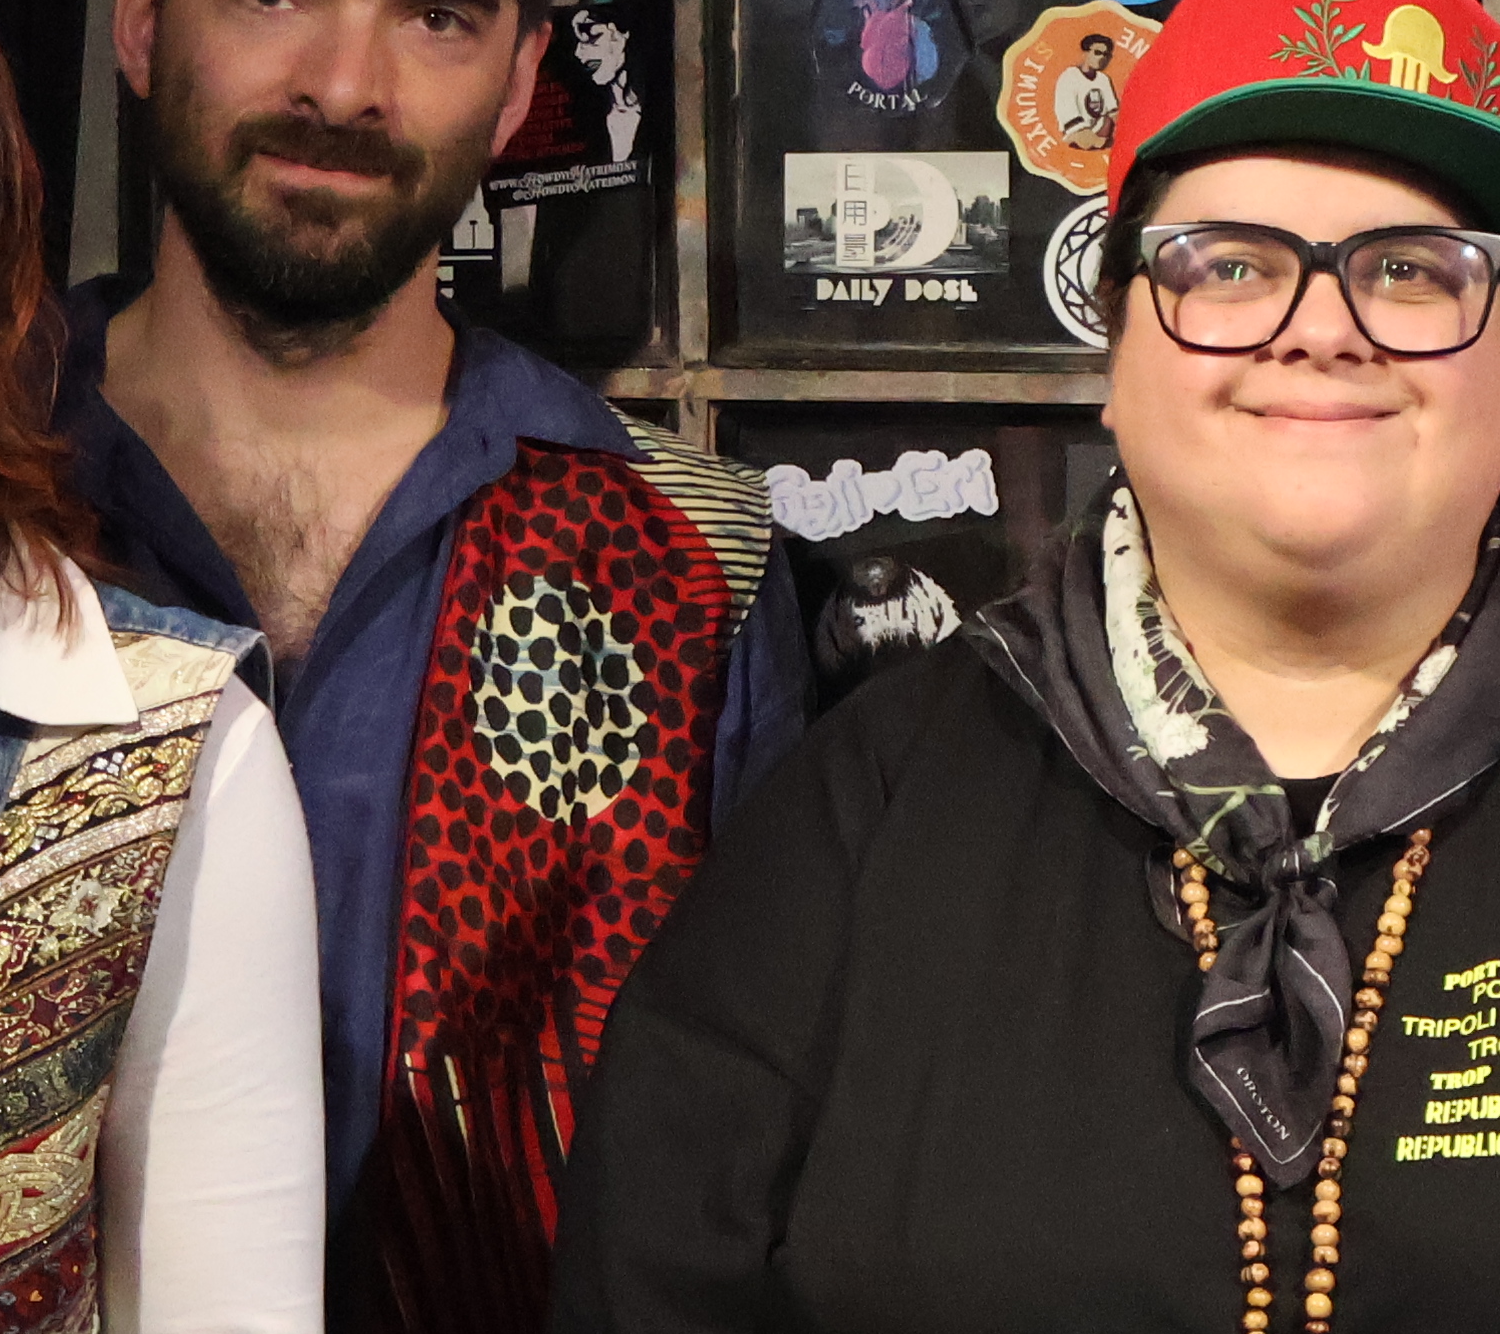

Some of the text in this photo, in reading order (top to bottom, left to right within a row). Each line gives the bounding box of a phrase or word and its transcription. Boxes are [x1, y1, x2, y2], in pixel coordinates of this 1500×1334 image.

[847, 81, 928, 111] PORTAL
[816, 278, 894, 306] DAILY
[905, 278, 978, 302] DOSE
[1401, 1008, 1497, 1038] TRIPOLI
[1430, 1065, 1492, 1090] TROP
